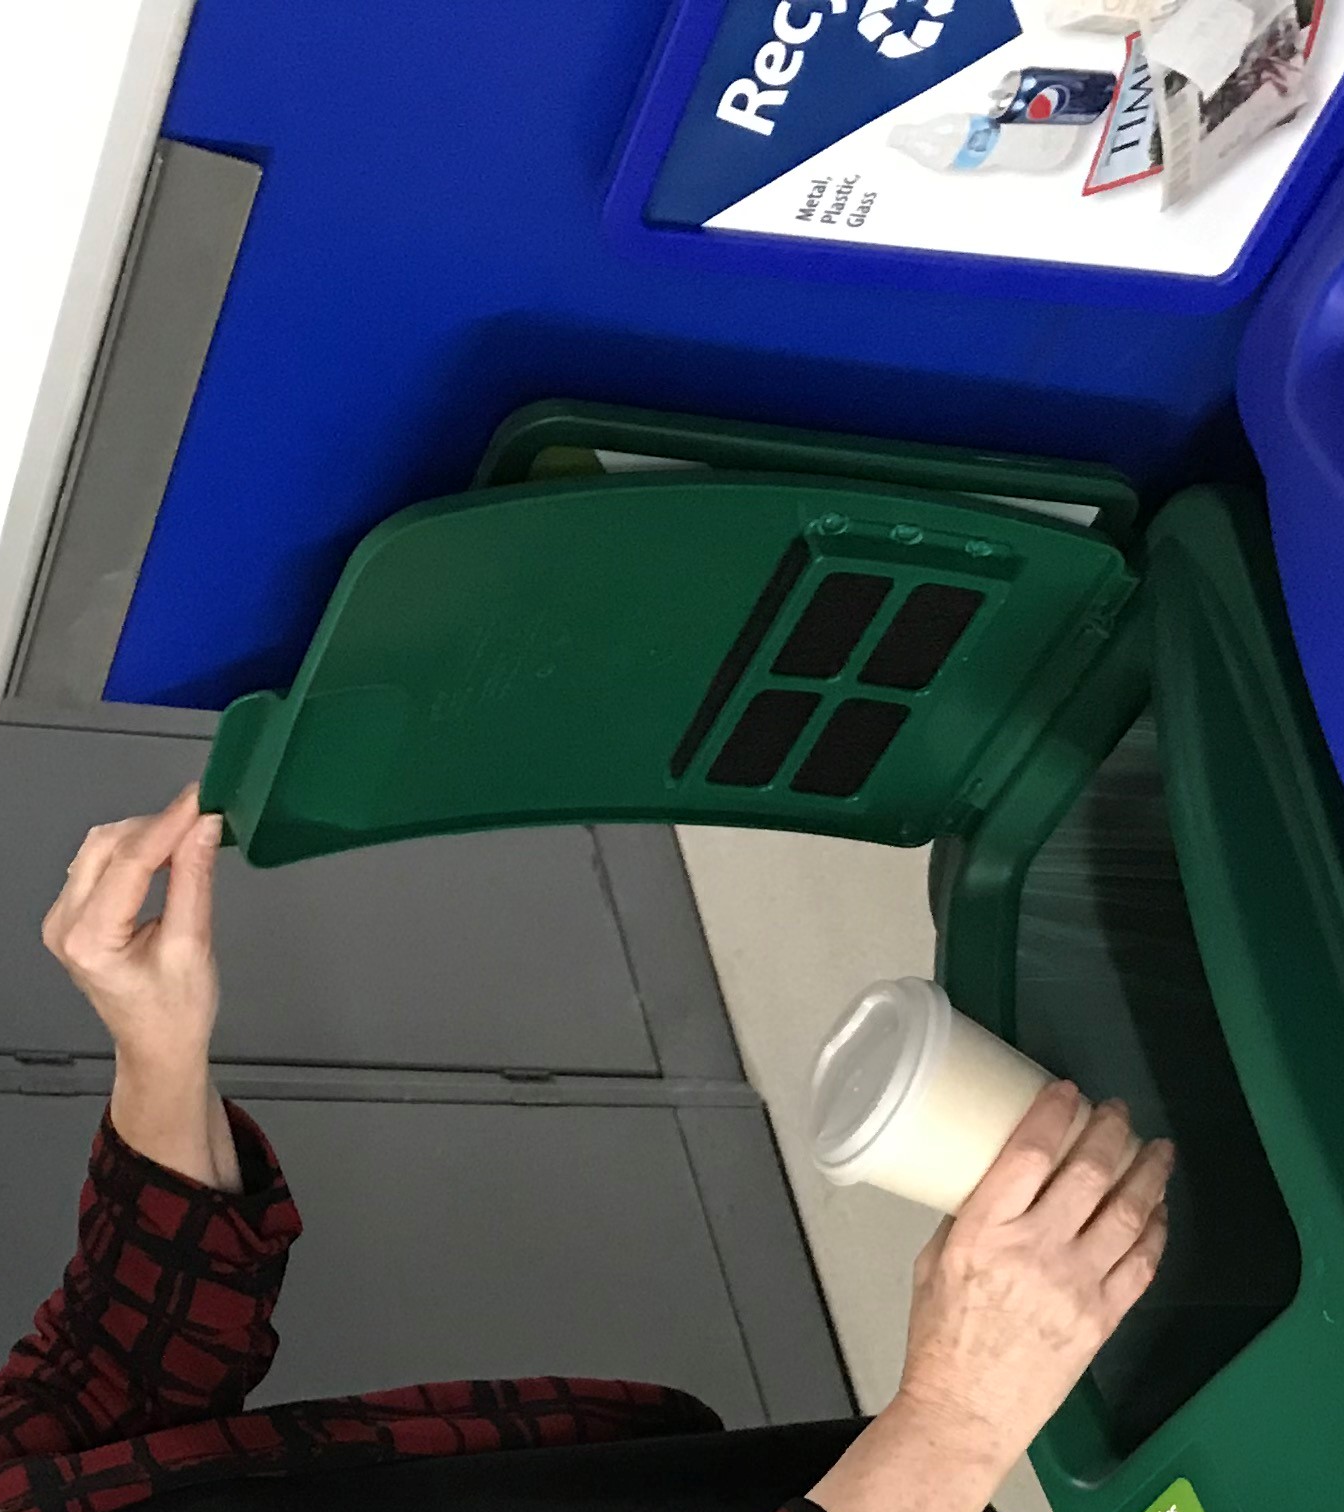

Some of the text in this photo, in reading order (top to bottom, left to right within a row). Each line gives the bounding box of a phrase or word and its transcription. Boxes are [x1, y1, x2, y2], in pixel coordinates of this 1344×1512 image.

[716, 0, 847, 136] Rec
[796, 177, 832, 222] Metal,
[820, 174, 861, 225] Plastic,
[846, 192, 877, 228] Glass
